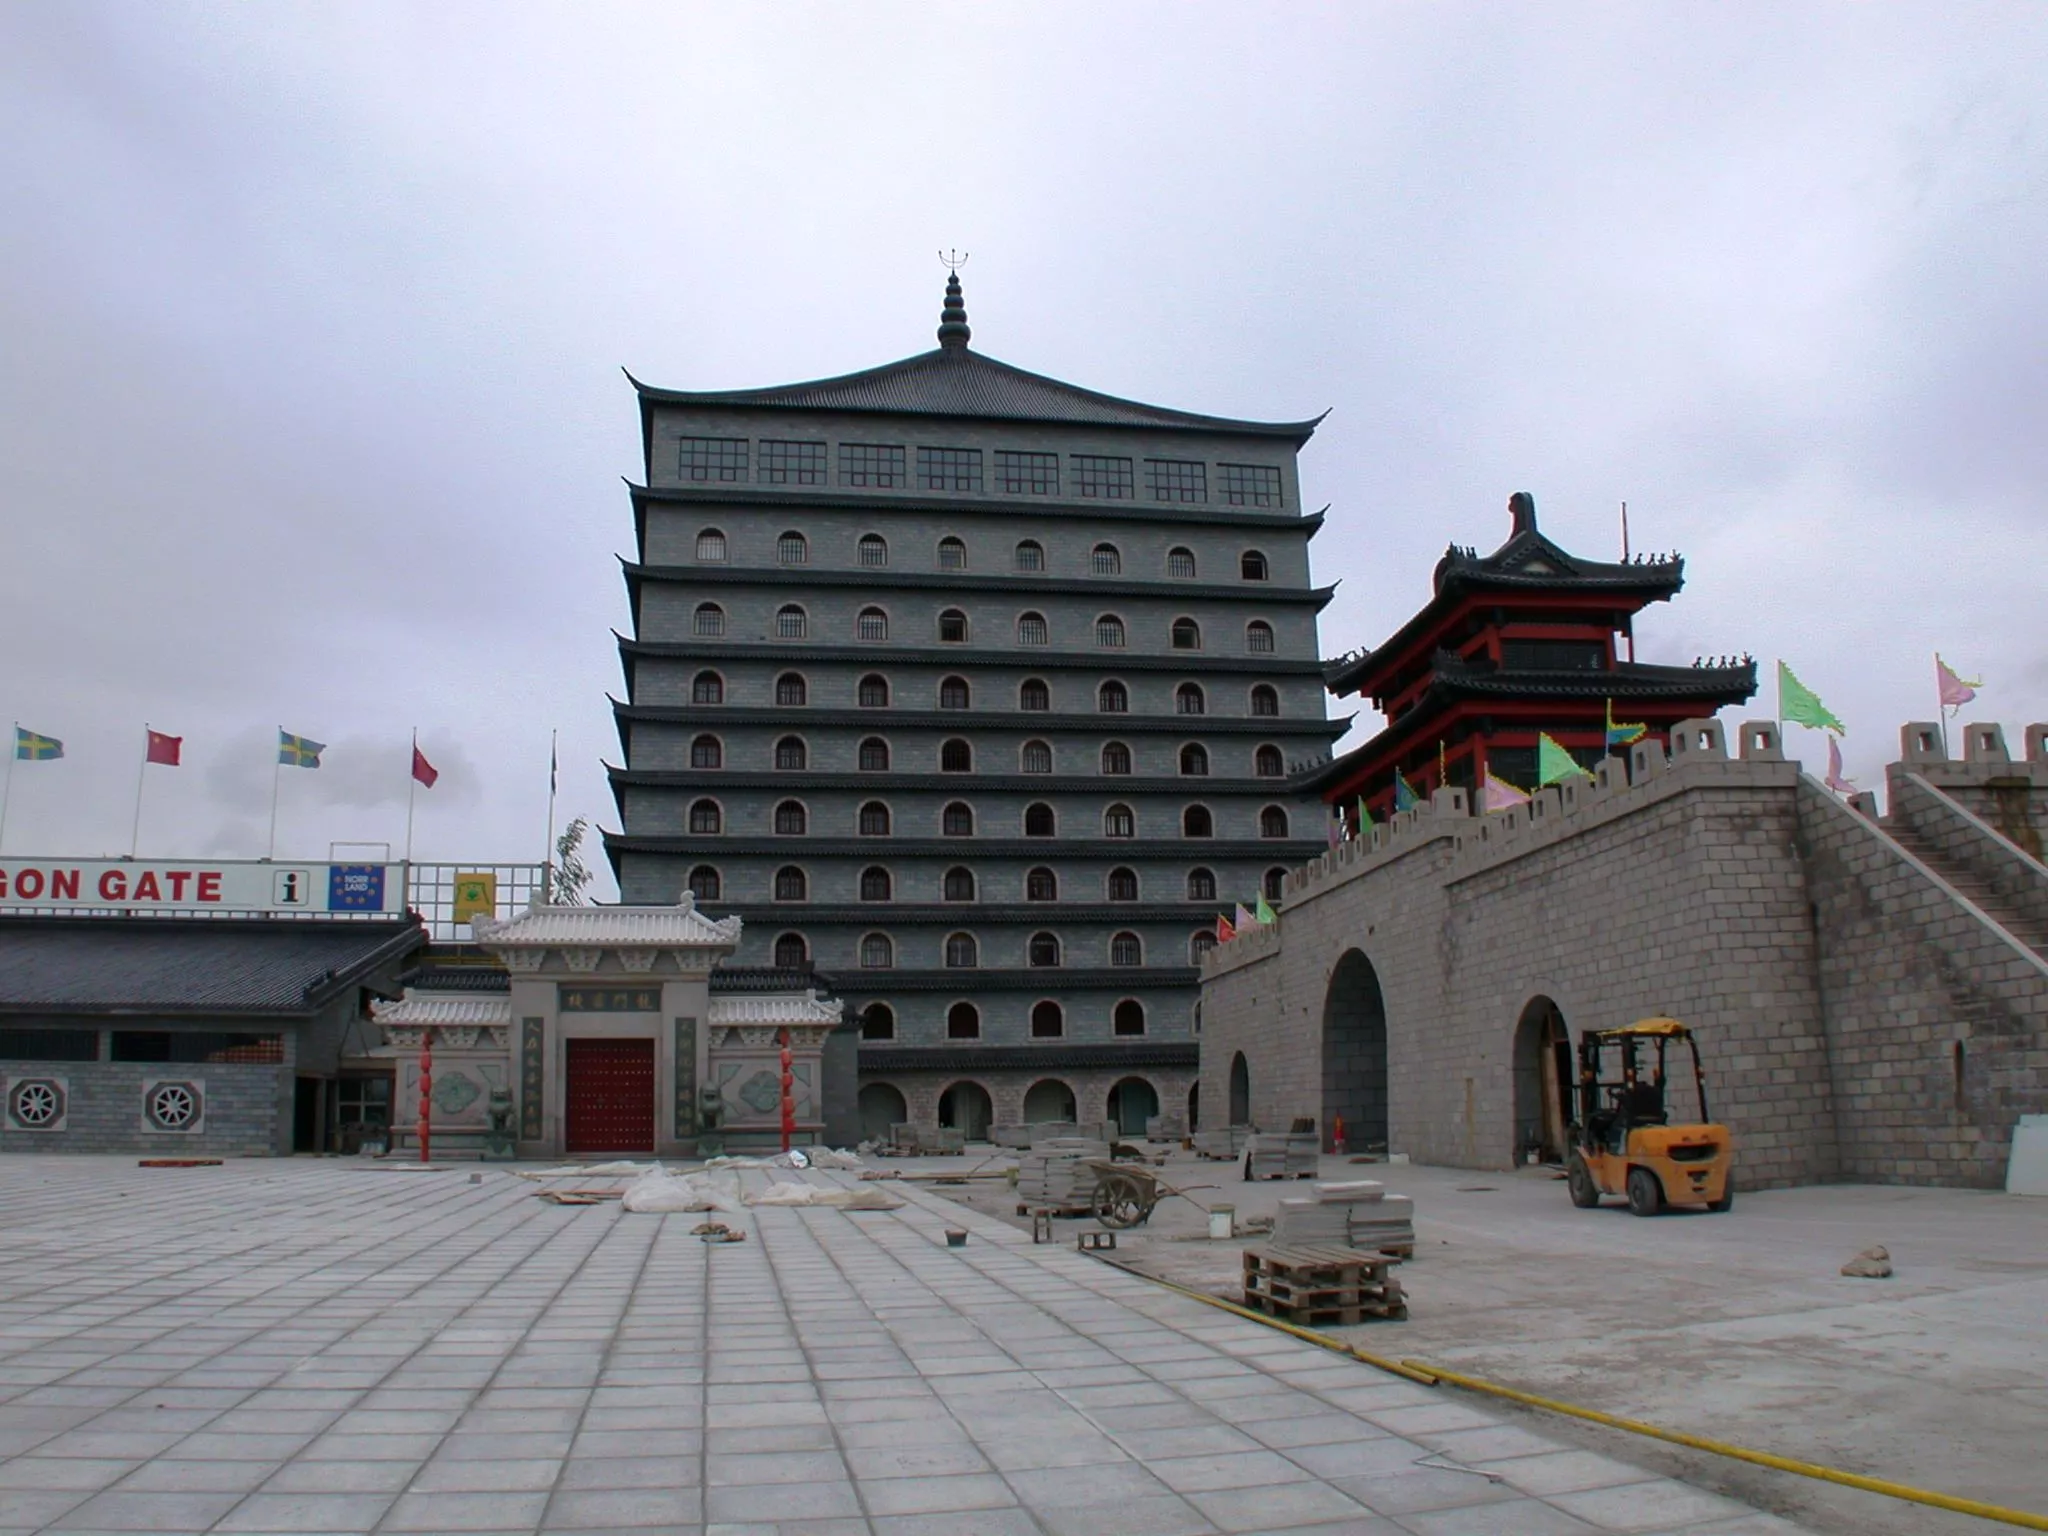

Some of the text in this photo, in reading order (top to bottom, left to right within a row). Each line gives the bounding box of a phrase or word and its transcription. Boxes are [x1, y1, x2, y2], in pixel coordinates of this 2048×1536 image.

[0, 869, 223, 901] ON GATE
[344, 883, 368, 891] LAND
